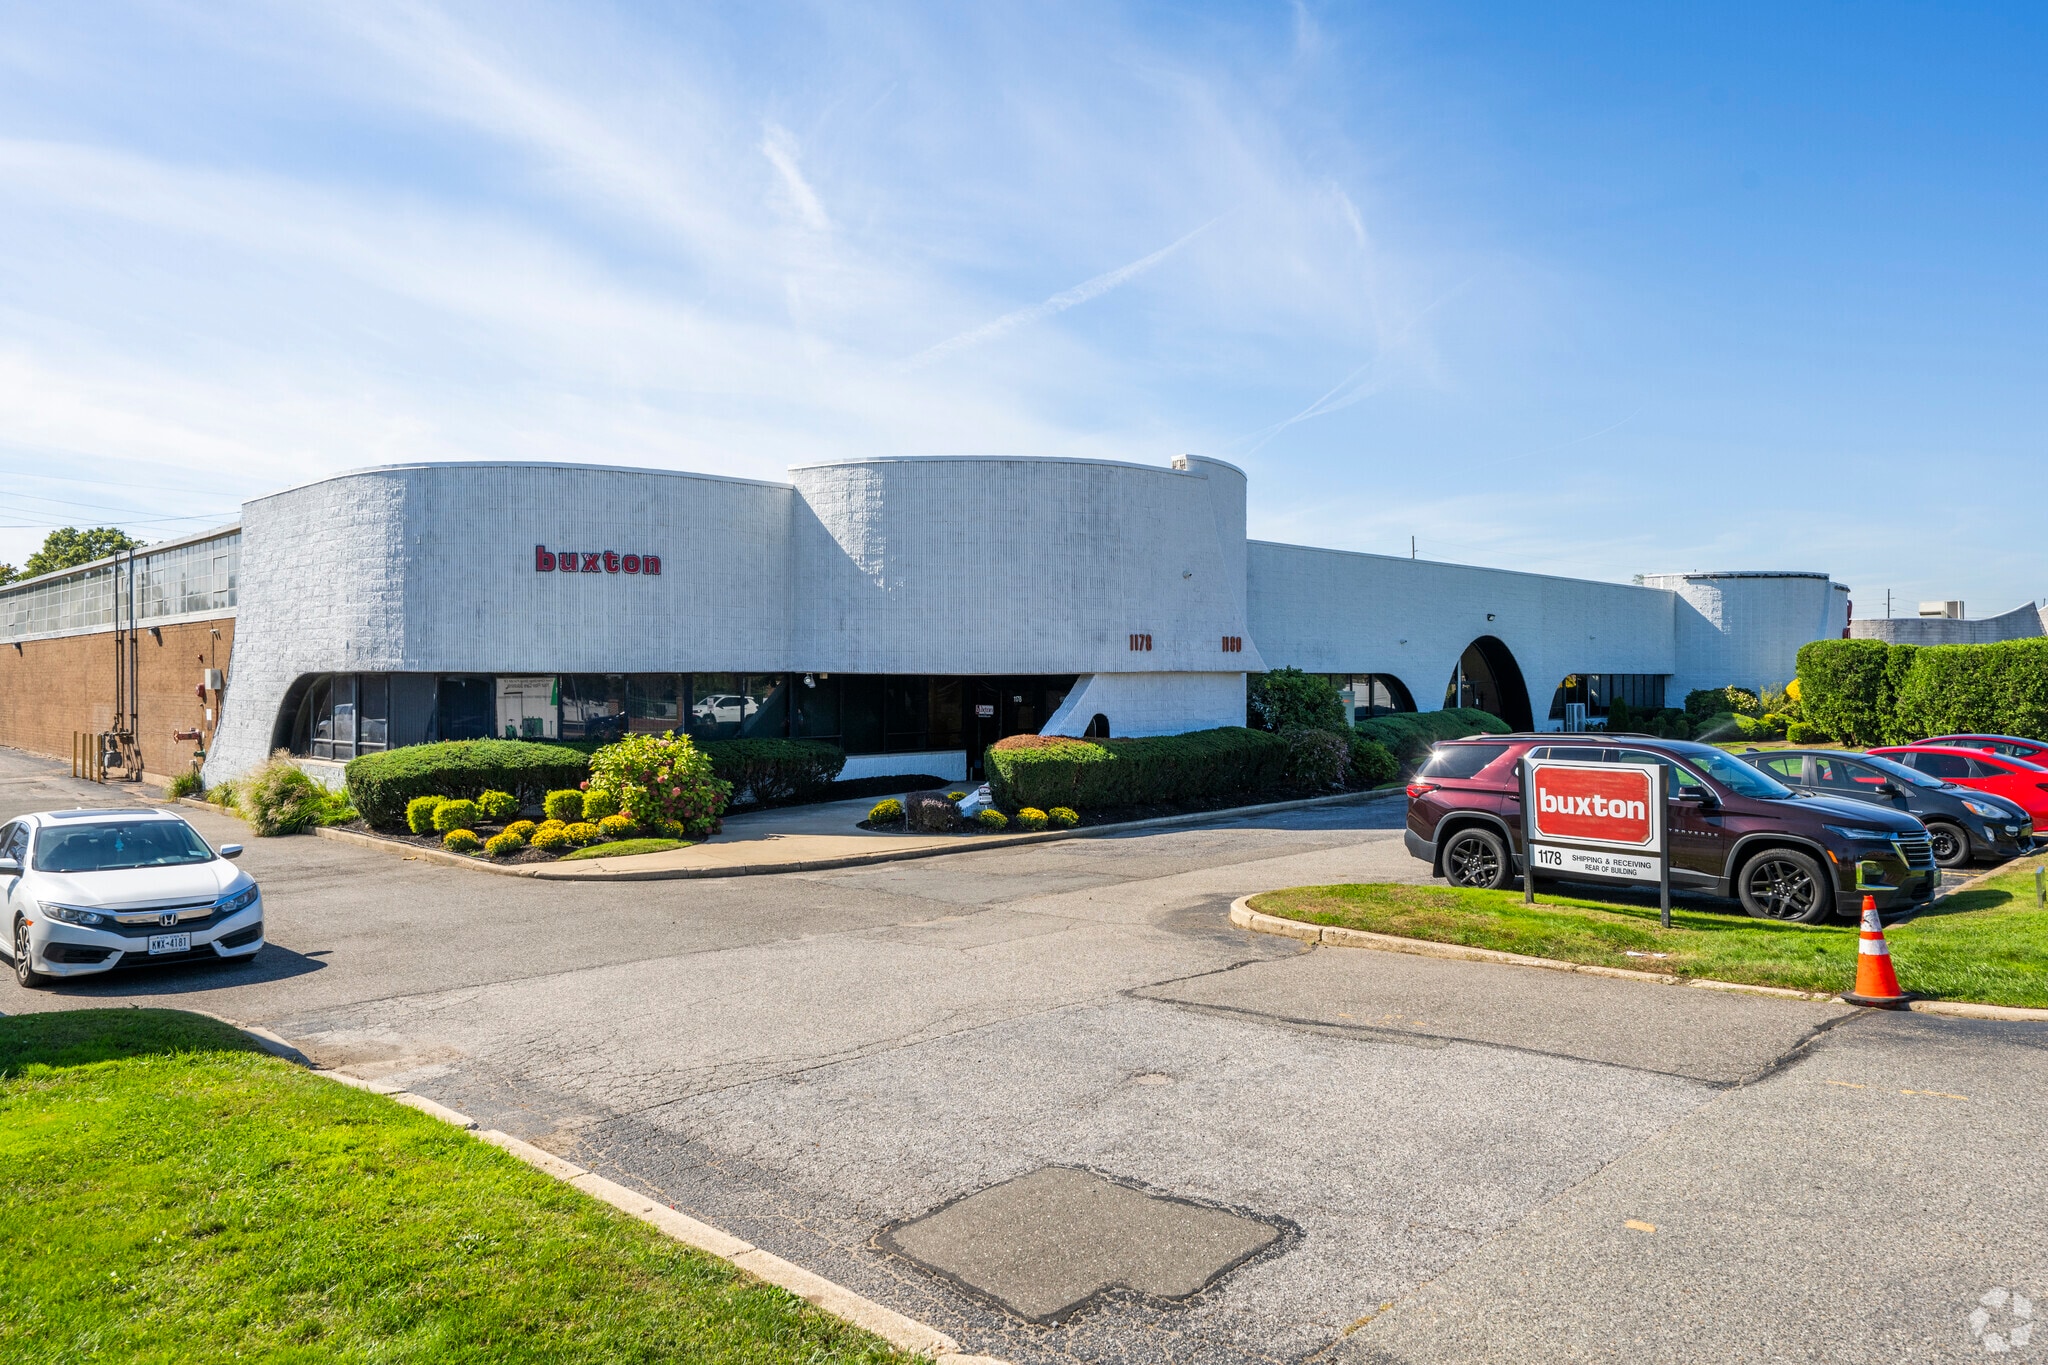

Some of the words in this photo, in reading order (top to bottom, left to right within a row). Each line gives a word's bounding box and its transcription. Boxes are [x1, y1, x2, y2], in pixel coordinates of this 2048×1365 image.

[535, 545, 662, 575] buxton
[1129, 633, 1153, 651] 1178
[1221, 636, 1242, 653] 1180
[1539, 787, 1646, 821] buxton
[1538, 850, 1562, 866] 1178
[1571, 854, 1603, 865] SHIPPING
[1613, 859, 1652, 869] RECEIVING
[1584, 864, 1600, 872] REAR
[1610, 867, 1638, 876] BUILDING
